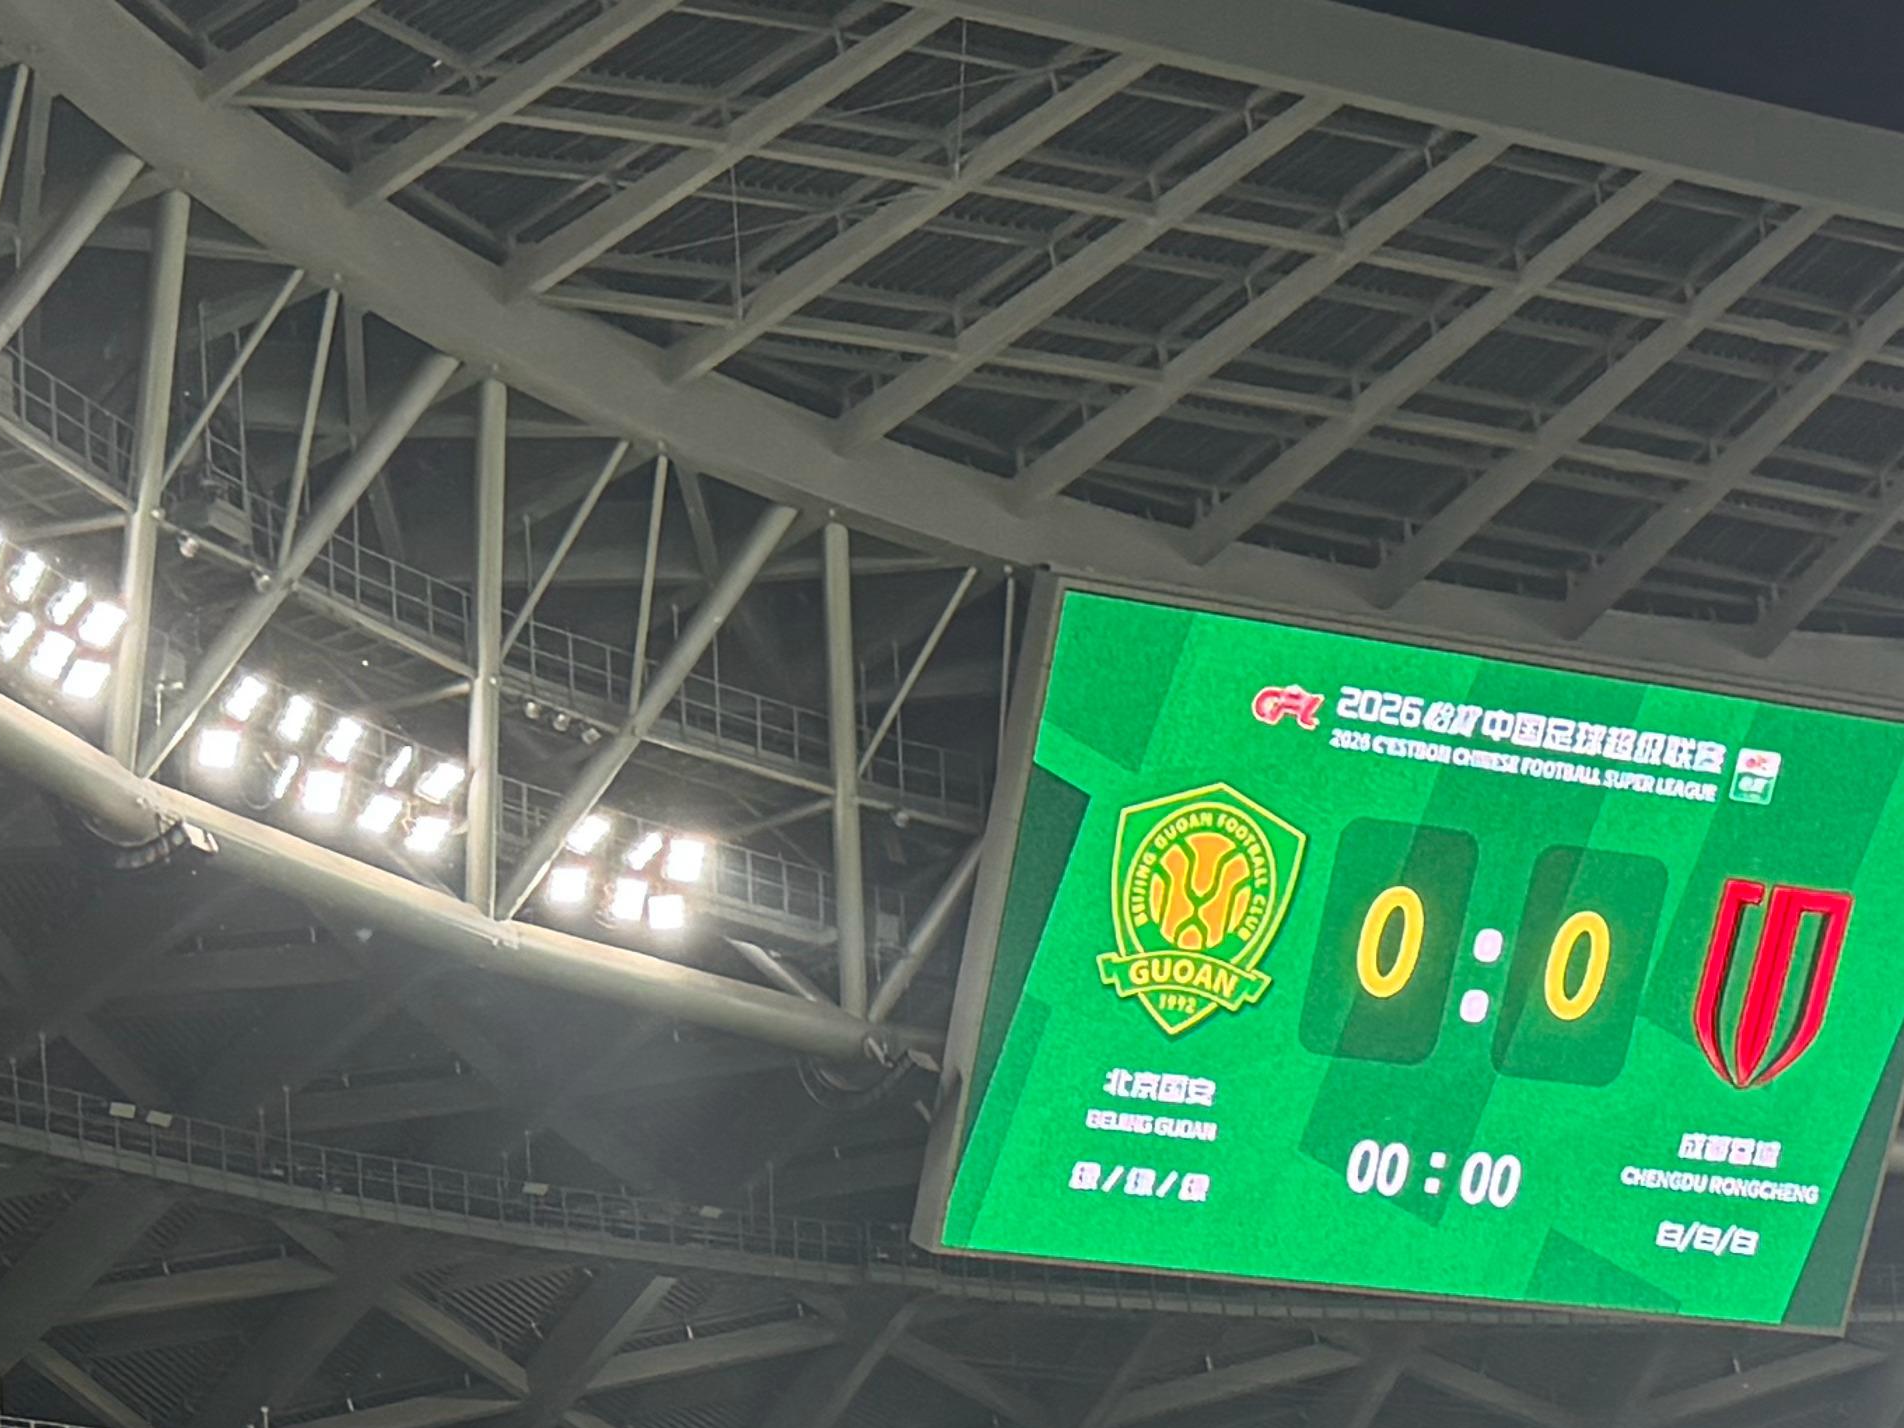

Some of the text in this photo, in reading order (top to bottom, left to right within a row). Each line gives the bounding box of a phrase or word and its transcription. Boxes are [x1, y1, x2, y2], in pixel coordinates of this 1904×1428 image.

[1520, 757, 1601, 787] FOOTBALL
[1603, 769, 1655, 794] SUPER
[1656, 777, 1718, 803] LEAGUE
[1216, 812, 1269, 889] FOOTBALL
[1356, 885, 1425, 999] 0
[1544, 910, 1611, 1021] 0
[1129, 957, 1239, 999] GUOAN
[1620, 1165, 1820, 1205] CHENGDU RONGCHENG
